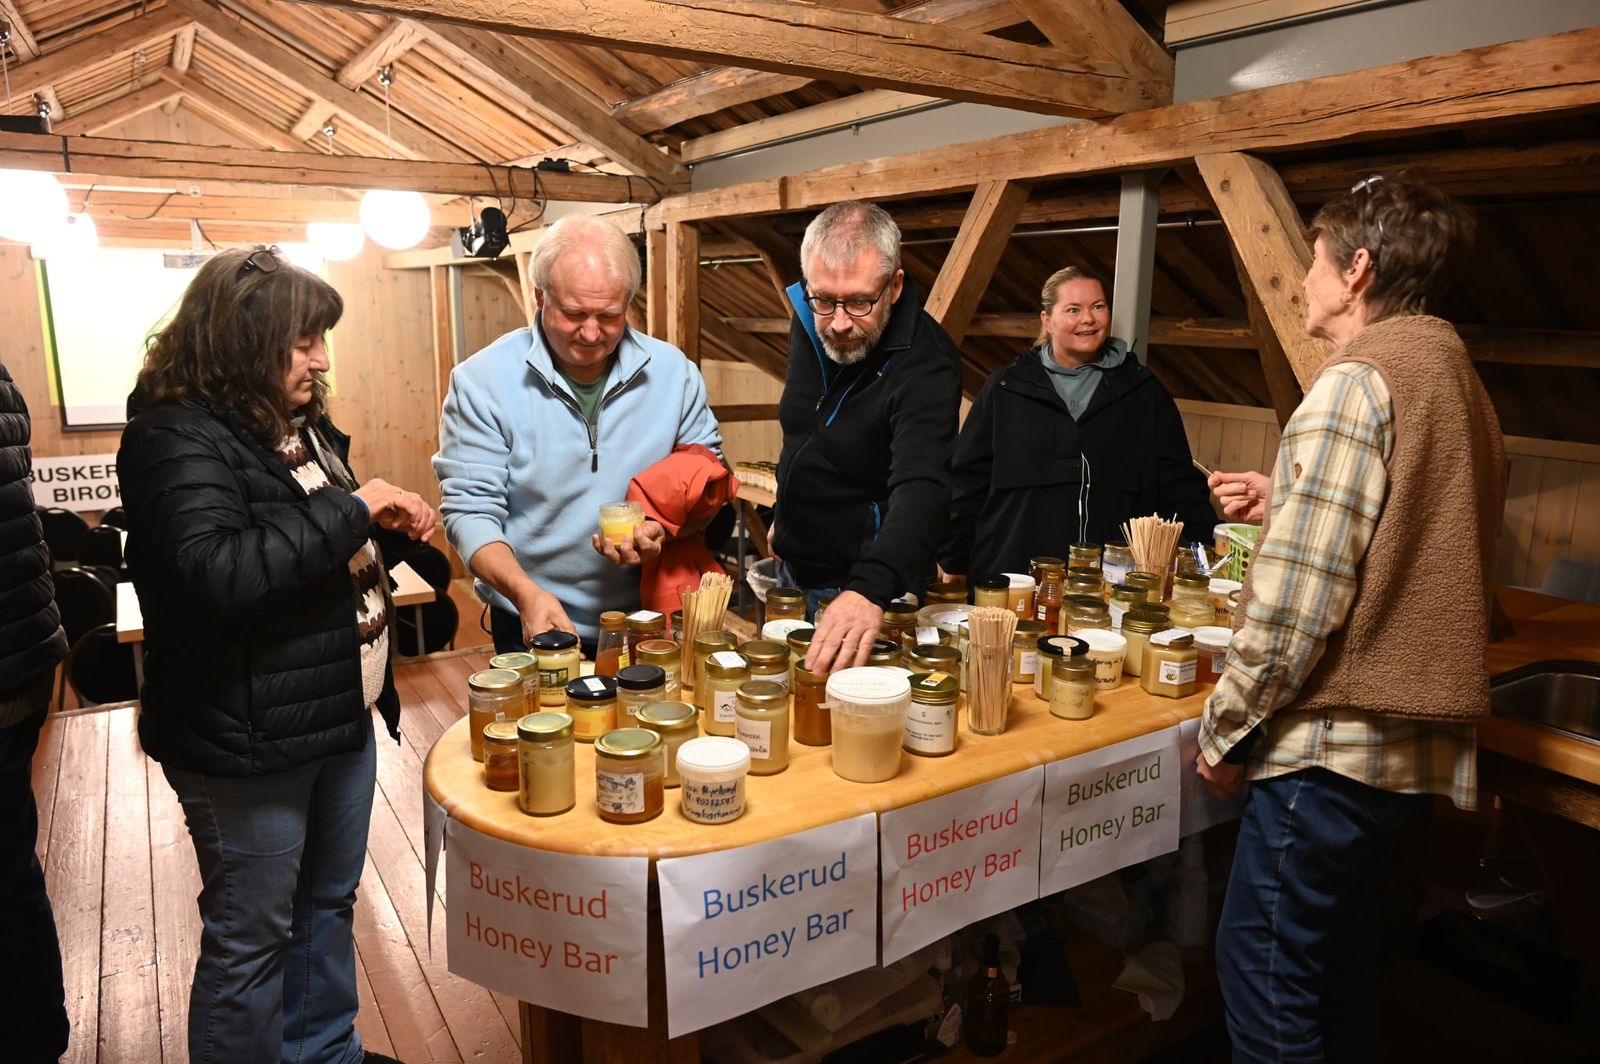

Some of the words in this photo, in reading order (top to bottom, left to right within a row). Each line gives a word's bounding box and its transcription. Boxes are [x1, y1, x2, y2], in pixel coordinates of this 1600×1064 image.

[1067, 756, 1161, 806] Buskerud
[907, 800, 1019, 859] Buskerud
[1061, 815, 1125, 851] Honey
[1132, 801, 1165, 828] Bar
[470, 861, 608, 920] Buskerud
[704, 852, 847, 920] Buskerud
[902, 864, 976, 912] Honey
[984, 848, 1022, 878] Bar
[465, 911, 553, 969] Honey
[563, 942, 619, 975] Bar
[699, 927, 796, 978] Honey
[807, 908, 854, 942] Bar
